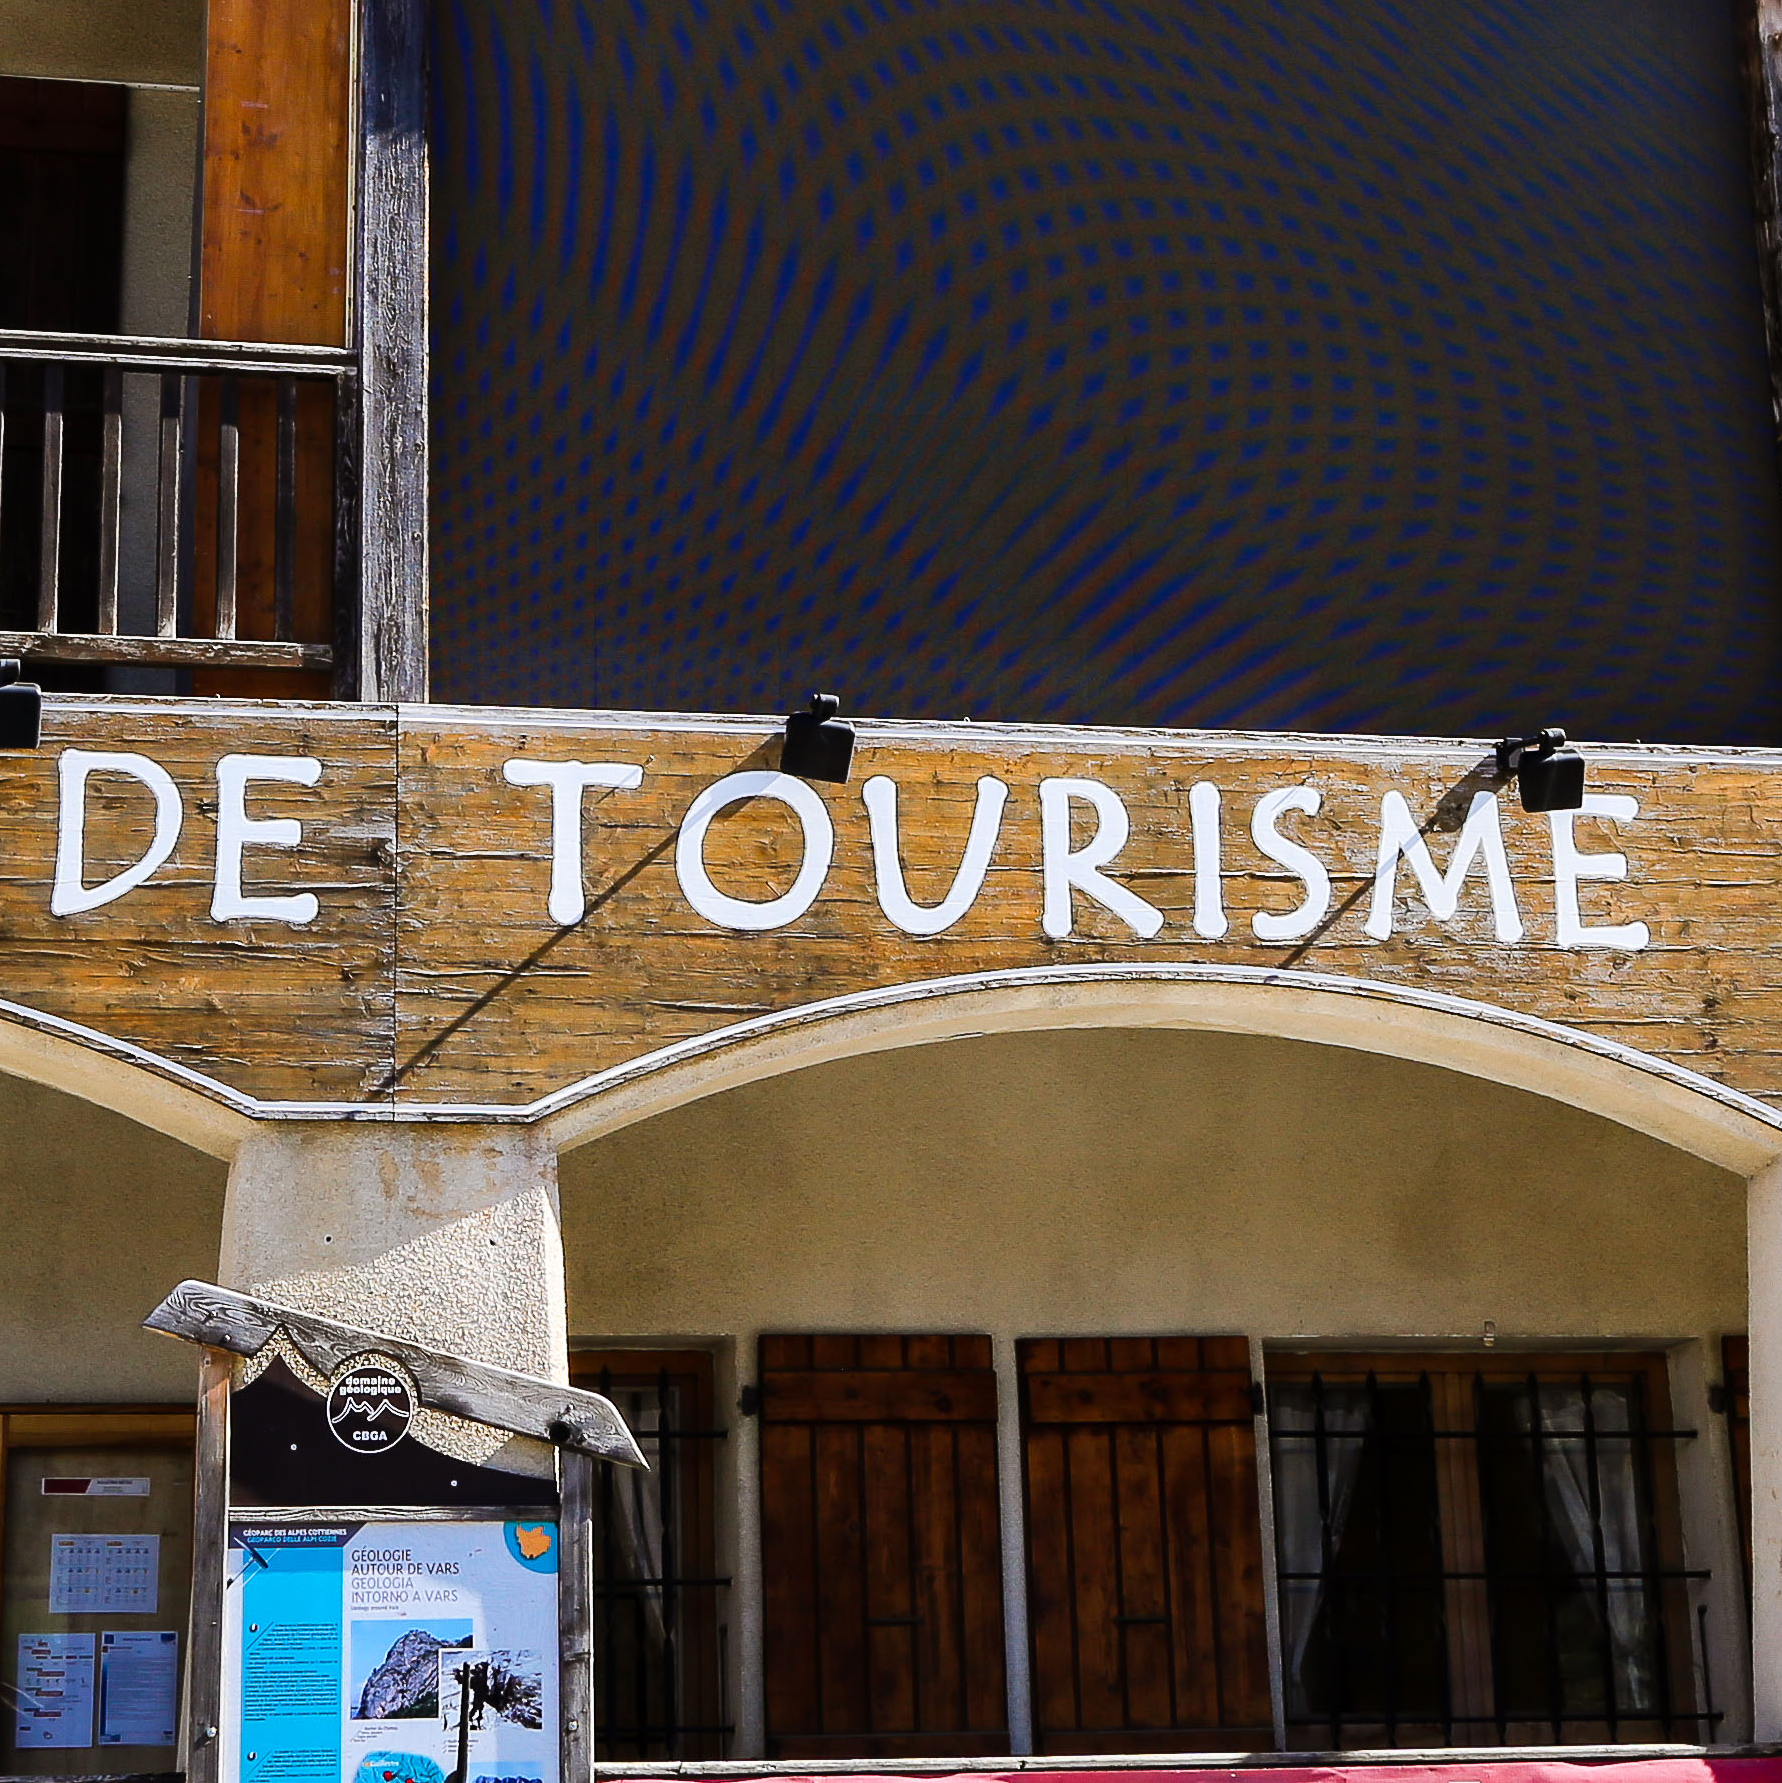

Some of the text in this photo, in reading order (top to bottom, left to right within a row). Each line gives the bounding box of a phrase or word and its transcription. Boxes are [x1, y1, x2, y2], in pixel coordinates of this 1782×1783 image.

[50, 747, 323, 924] DE
[502, 756, 1651, 952] TOURISME
[345, 1375, 396, 1385] domaine
[339, 1384, 402, 1396] géologique
[352, 1430, 388, 1441] CBGA
[351, 1545, 412, 1562] GÉOLOGIE
[351, 1562, 460, 1576] AUTOUR DE VARS
[351, 1577, 414, 1589] GEOLOGIA
[351, 1589, 458, 1603] INTORNO A VARS
